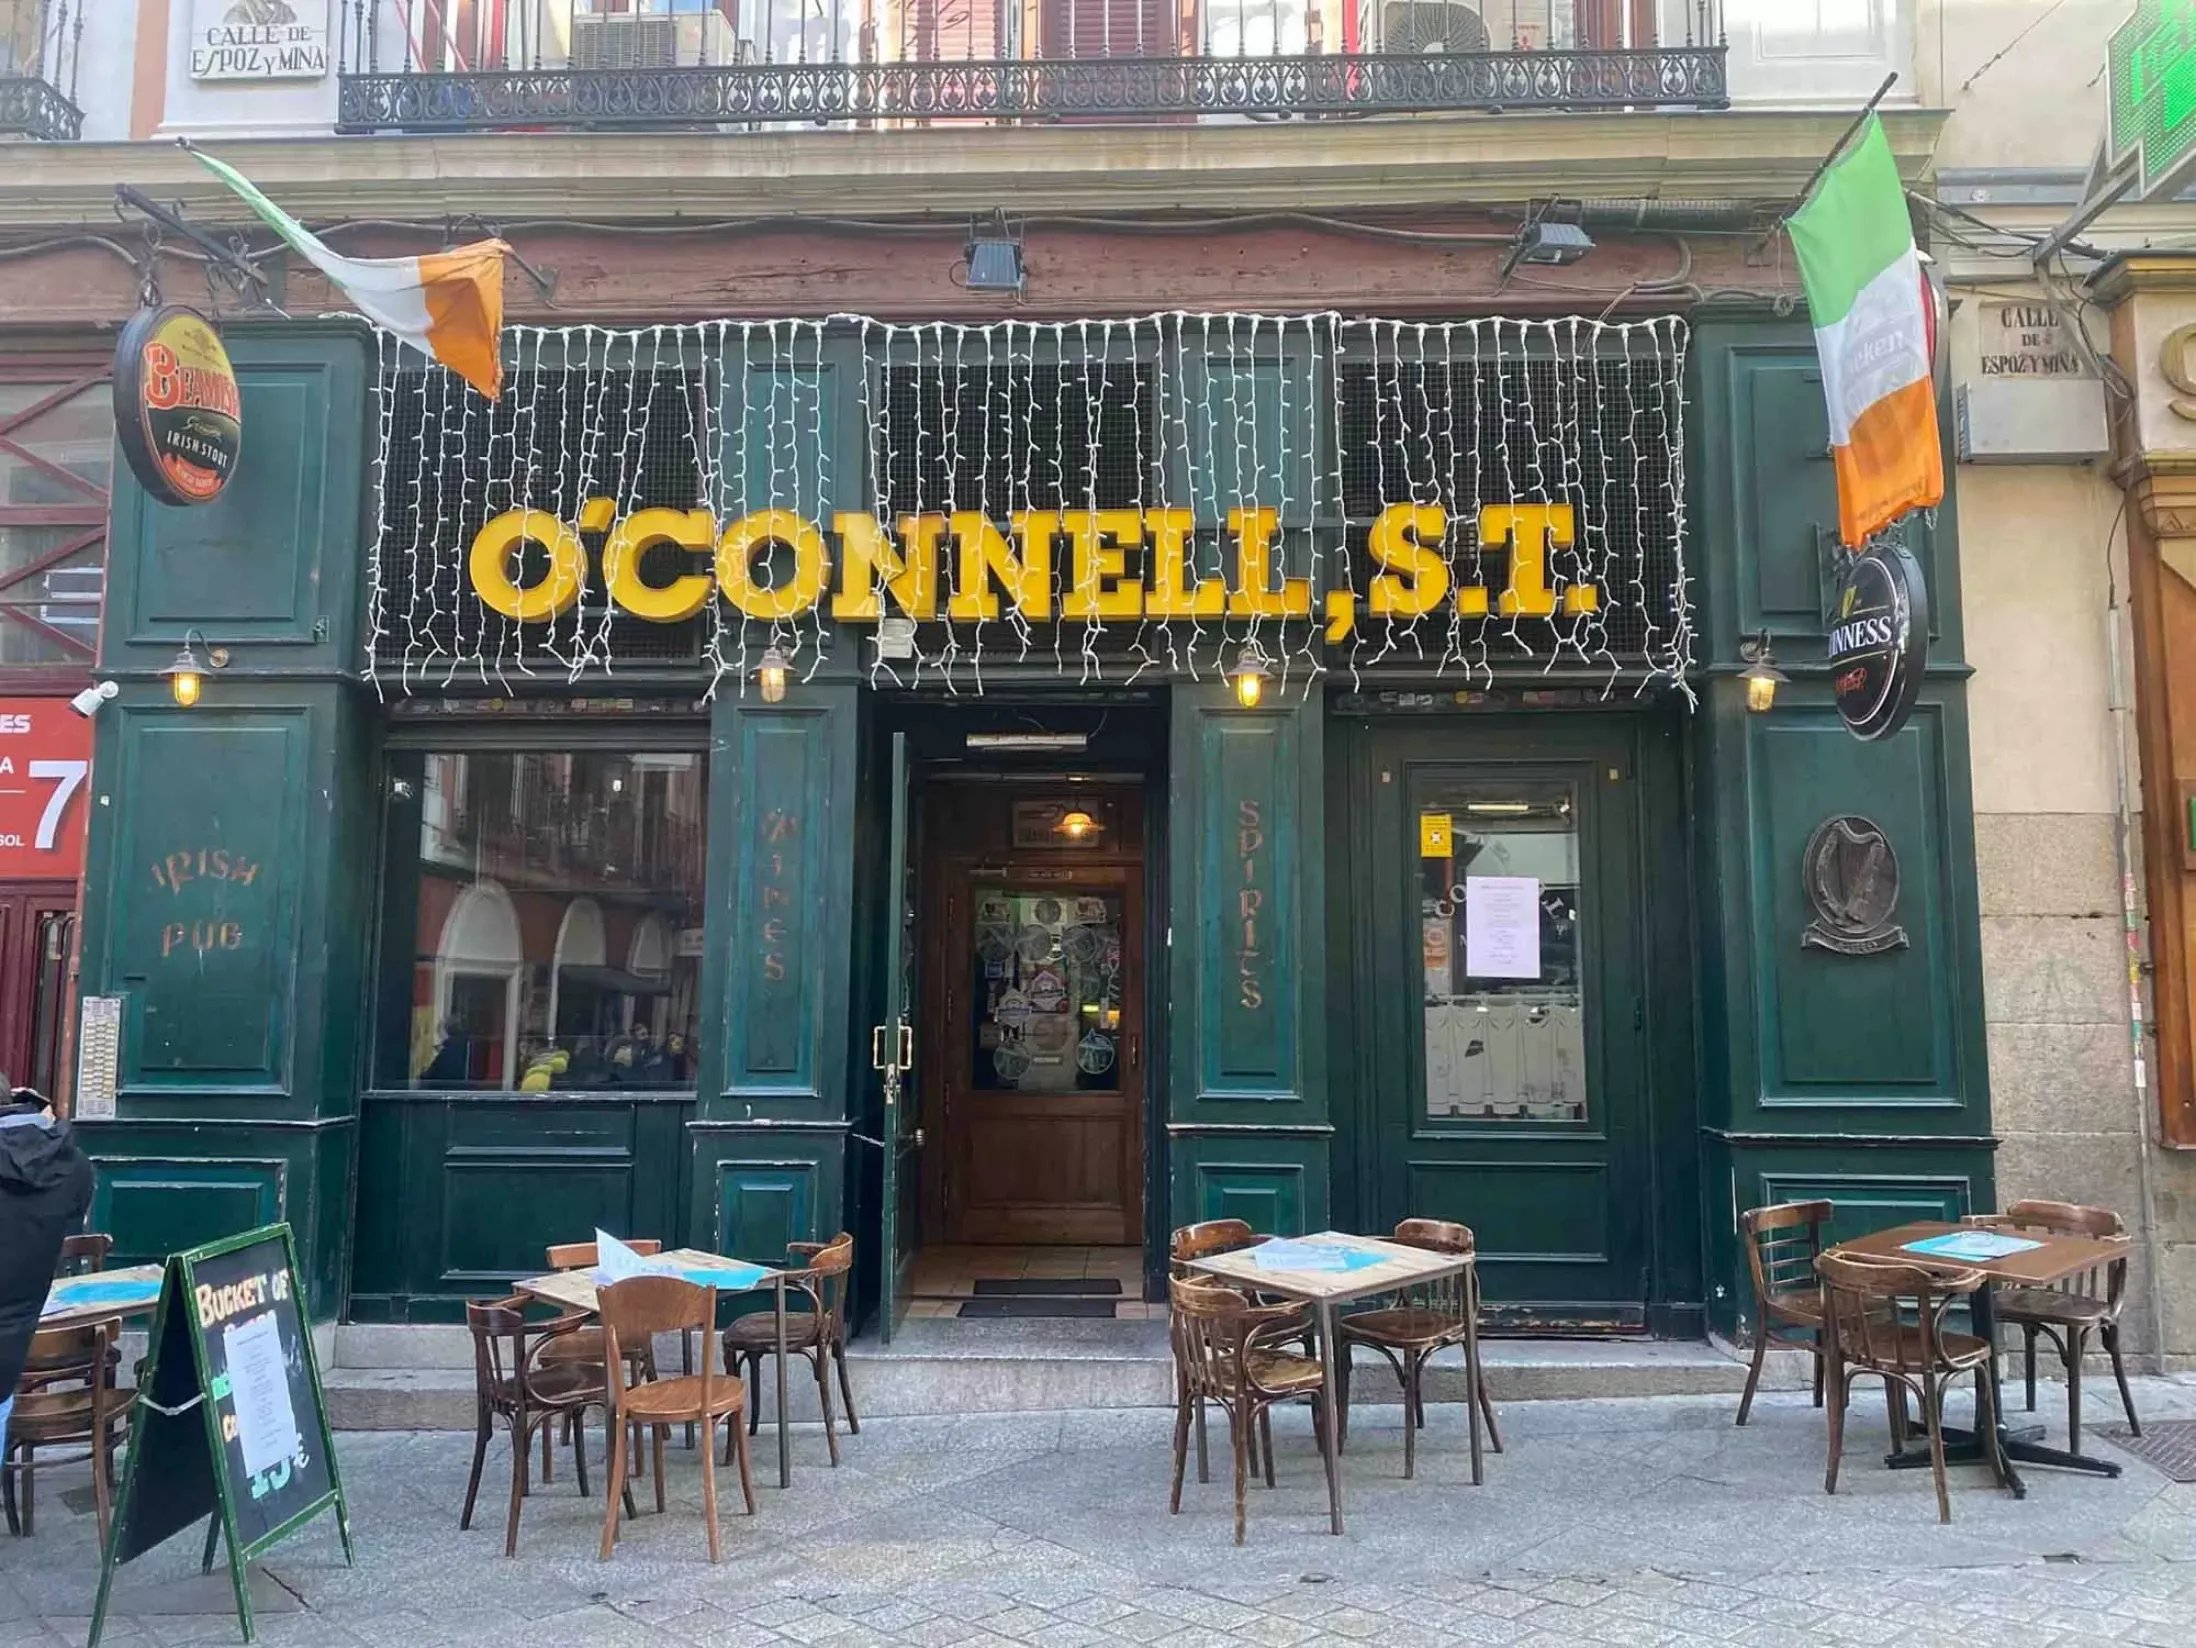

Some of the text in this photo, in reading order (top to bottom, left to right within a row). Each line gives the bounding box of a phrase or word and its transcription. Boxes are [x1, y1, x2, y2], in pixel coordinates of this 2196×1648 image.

[207, 25, 313, 46] CALLE DE
[278, 45, 325, 71] MINA
[2021, 333, 2041, 347] DE
[166, 429, 228, 470] IRISH STOUT
[1829, 614, 1893, 659] INNESS
[28, 760, 88, 849] 7
[151, 848, 259, 896] IRISH
[162, 919, 241, 957] PUB
[196, 1272, 268, 1329] BUCKET
[271, 1267, 290, 1301] OF
